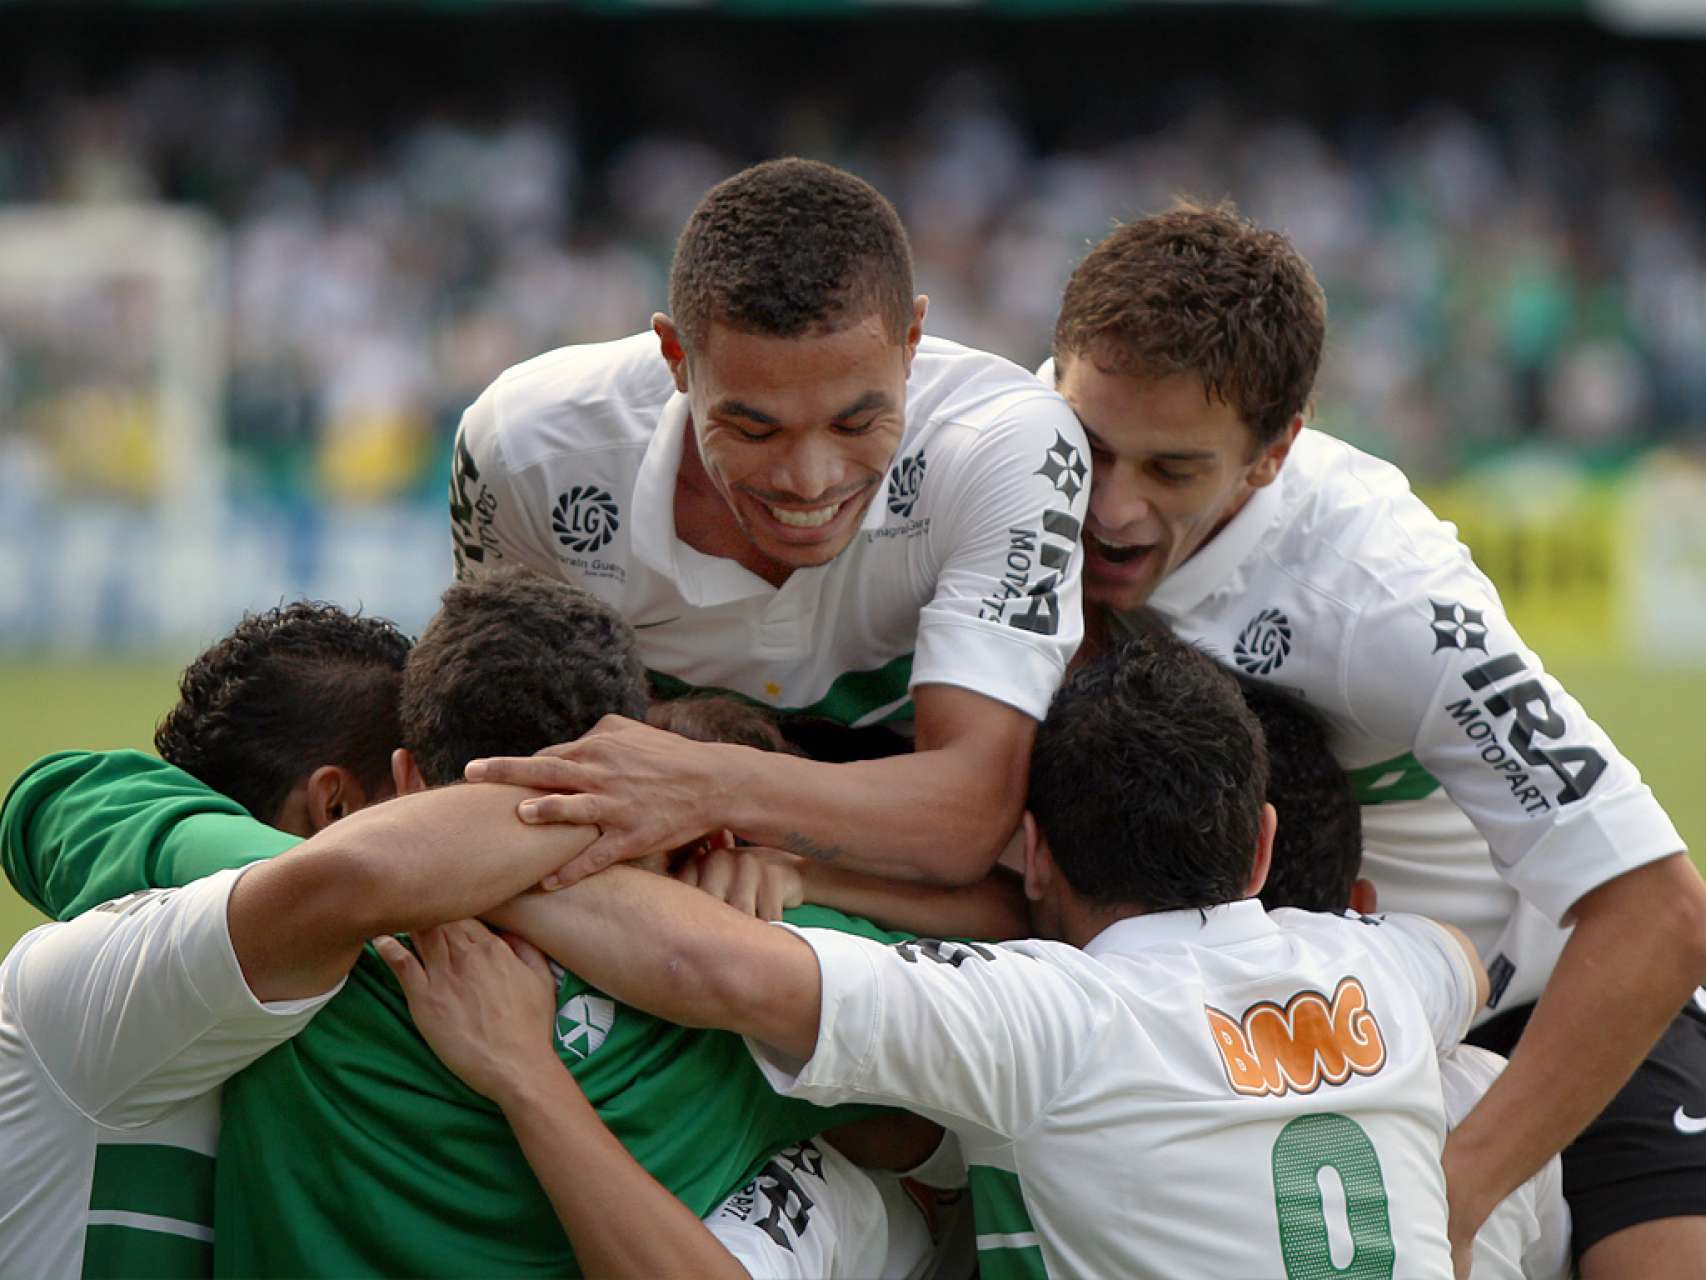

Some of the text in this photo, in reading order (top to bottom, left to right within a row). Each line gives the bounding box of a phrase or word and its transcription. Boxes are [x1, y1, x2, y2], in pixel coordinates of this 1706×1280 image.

[571, 503, 600, 534] LG
[1445, 698, 1551, 816] MOTOPART
[1462, 652, 1608, 805] IRA
[1204, 975, 1387, 1098] BMG
